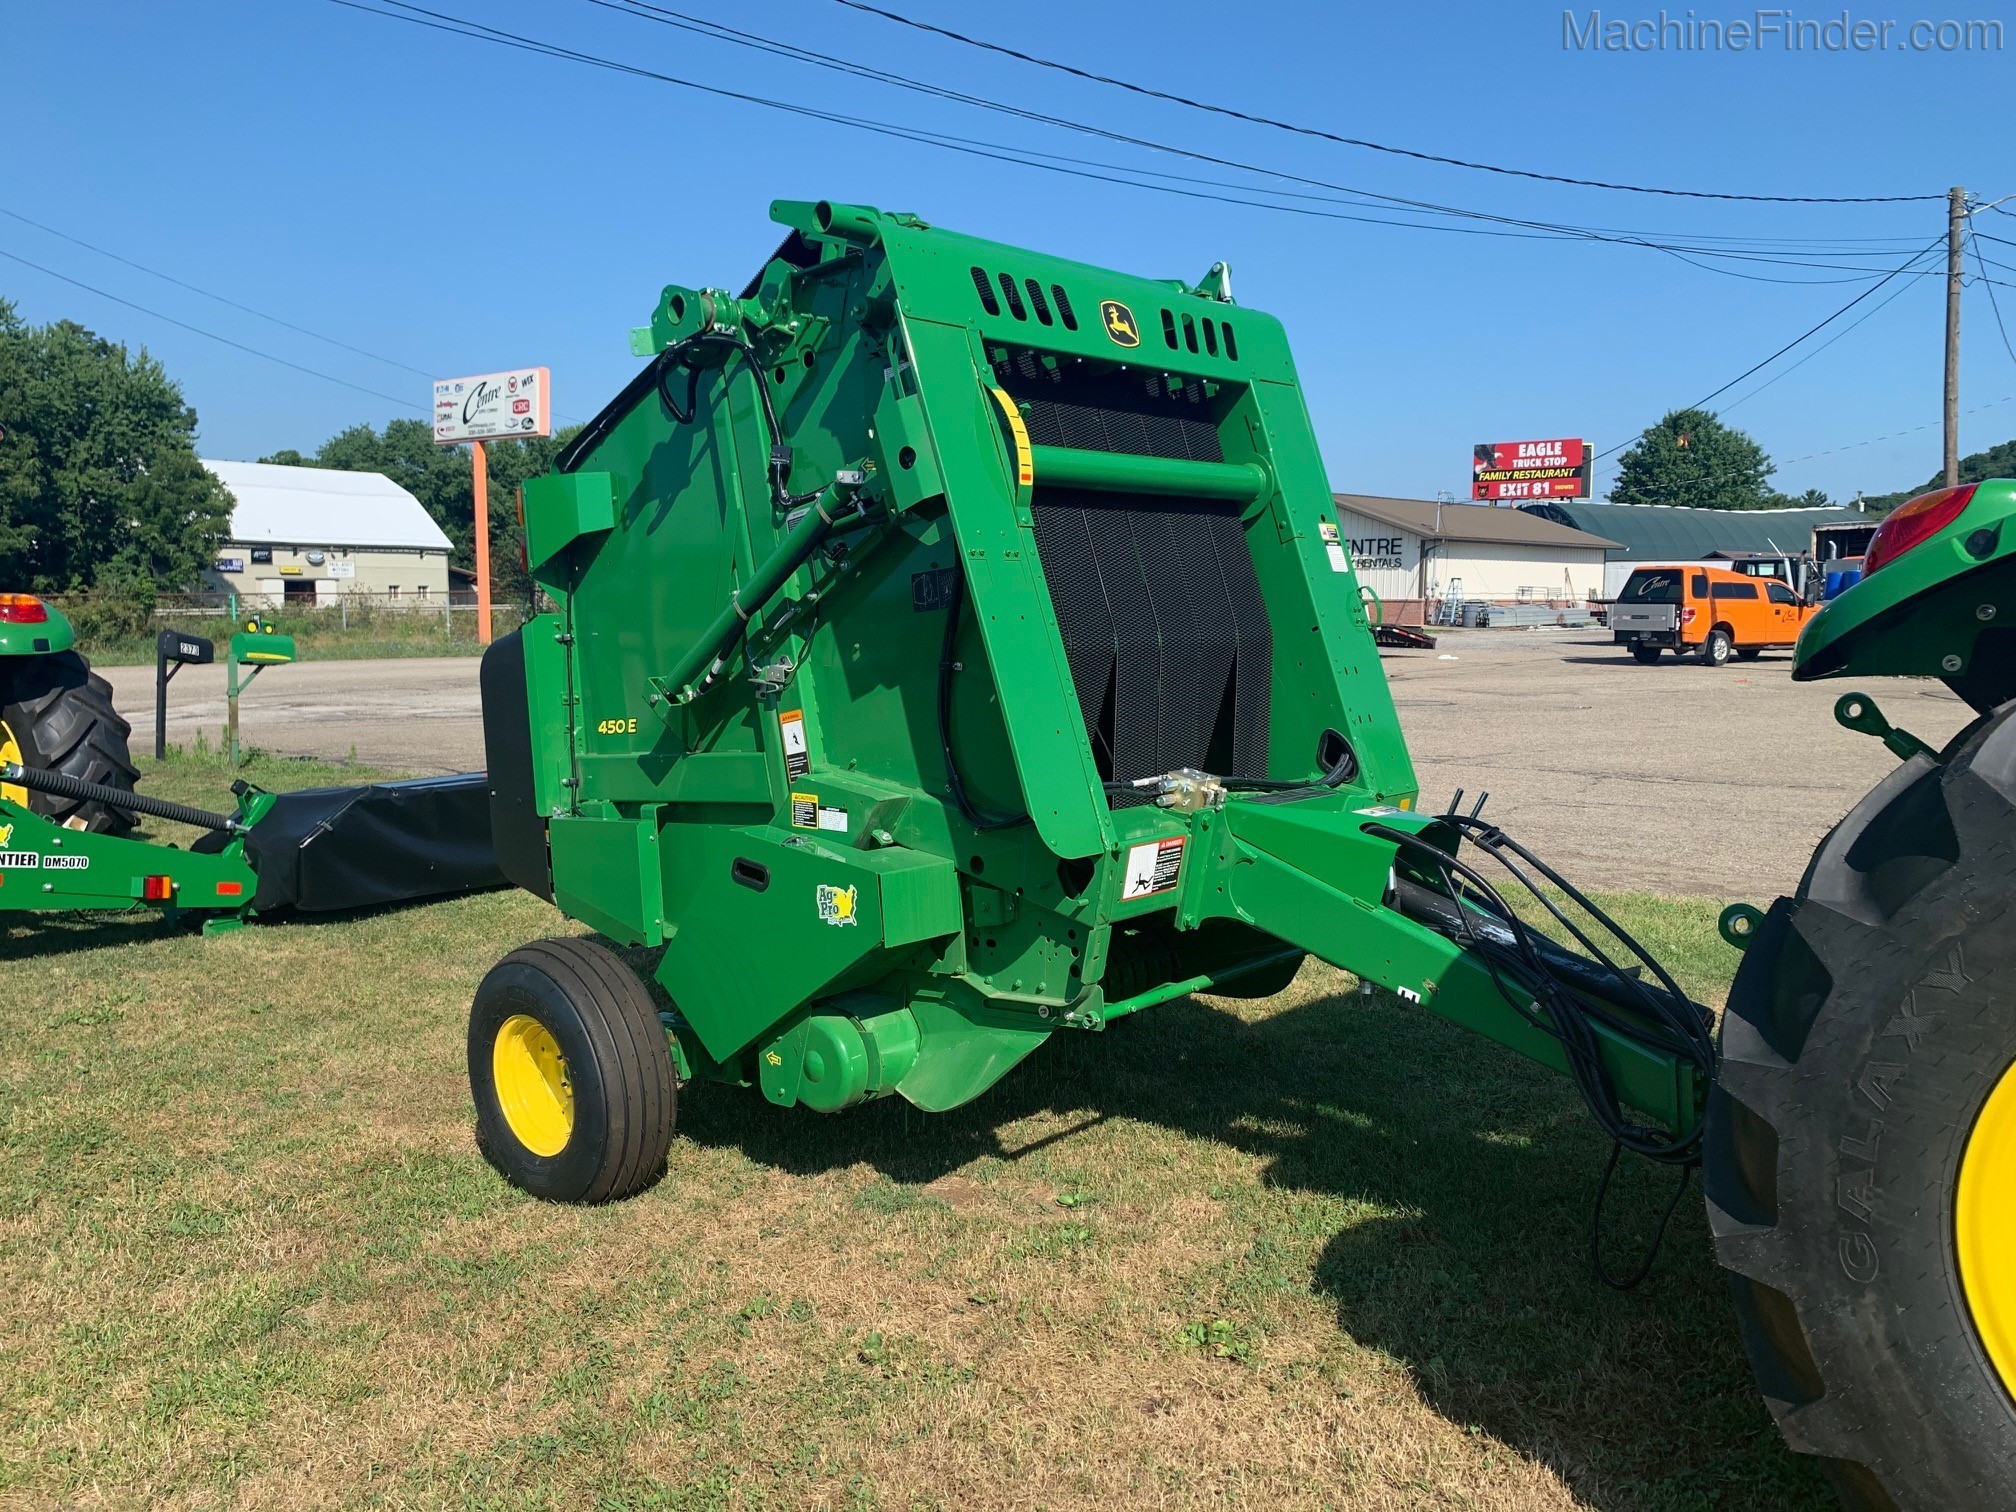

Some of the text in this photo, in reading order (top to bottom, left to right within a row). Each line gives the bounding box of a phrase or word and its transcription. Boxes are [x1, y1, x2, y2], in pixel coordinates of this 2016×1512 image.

[513, 402, 530, 412] CRC
[1518, 442, 1563, 457] EAGLE
[1512, 457, 1567, 468] TRUCK STOP
[1479, 468, 1575, 481] FAMILY RESTAURANT
[1500, 483, 1530, 496] EXIT
[1533, 482, 1550, 495] 81
[1345, 538, 1402, 555] NTRE
[1357, 558, 1402, 568] RENTALS
[181, 643, 199, 656] 2373
[598, 718, 637, 735] 450 E
[45, 856, 88, 868] DM5070
[820, 888, 832, 904] Ag
[821, 902, 839, 915] Pro
[1837, 942, 1974, 1283] GALAXY
